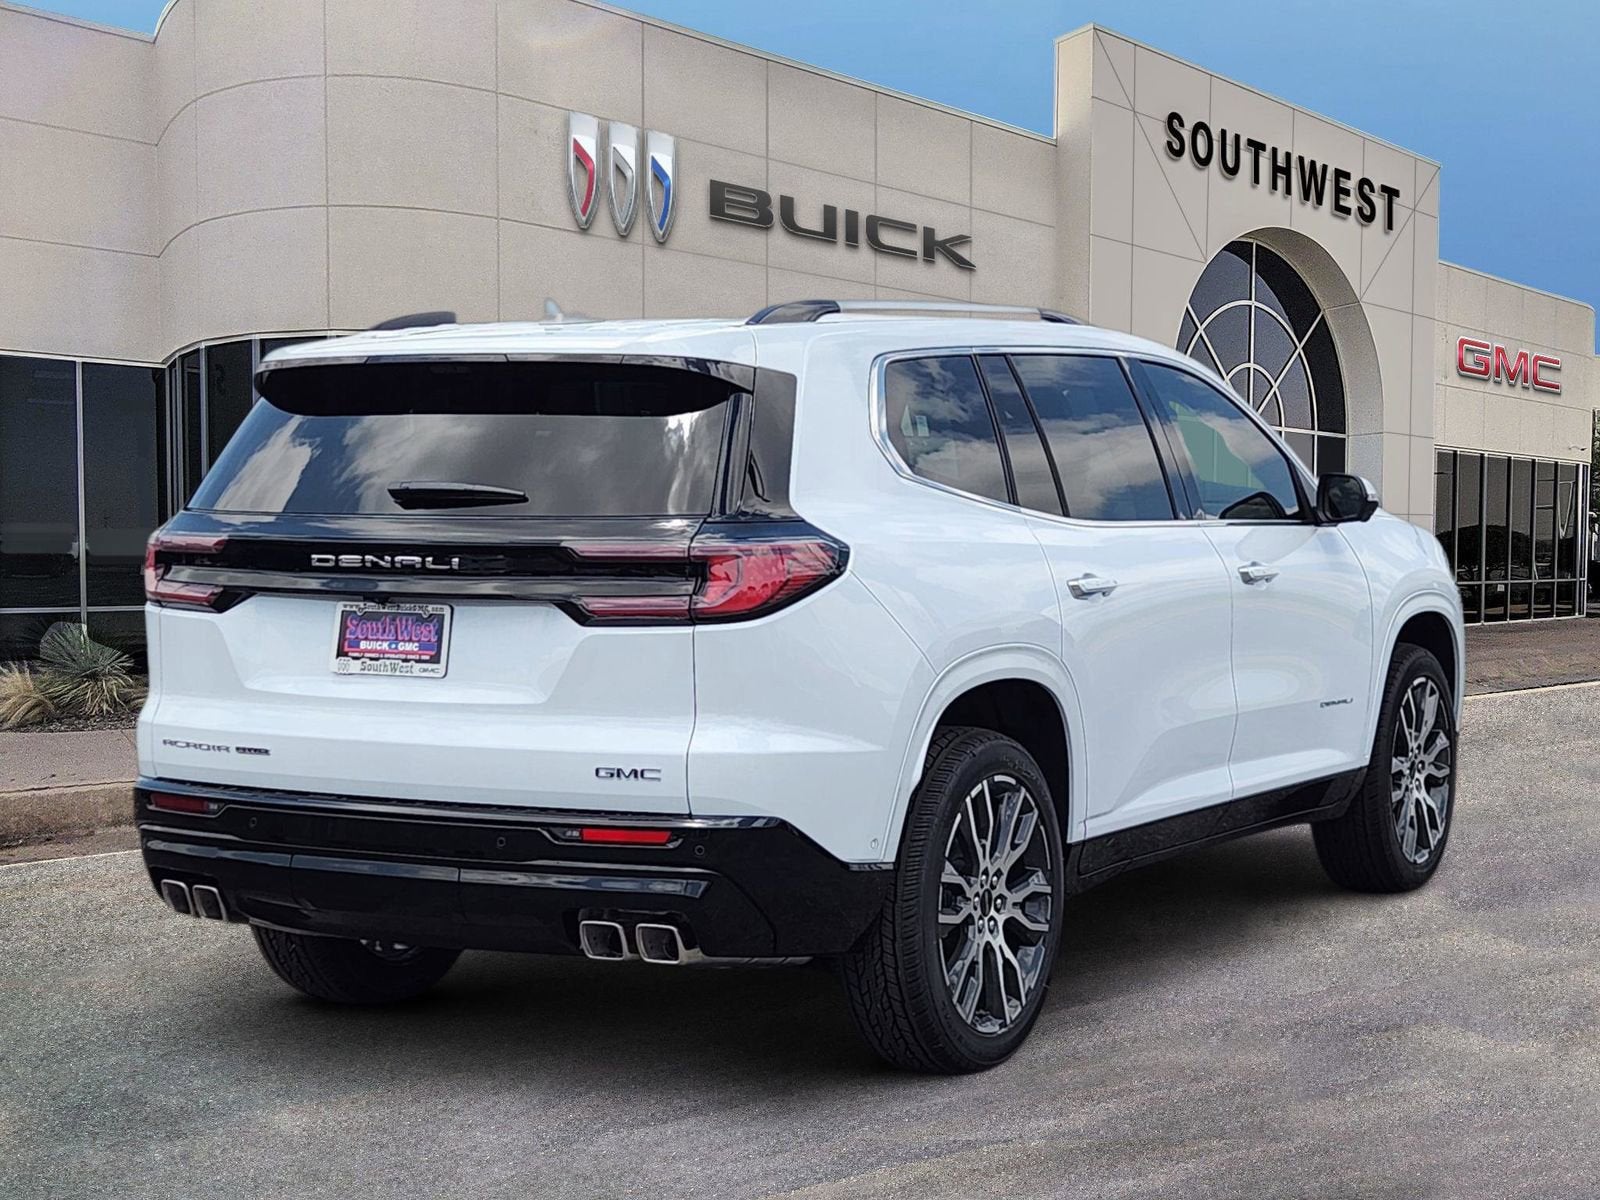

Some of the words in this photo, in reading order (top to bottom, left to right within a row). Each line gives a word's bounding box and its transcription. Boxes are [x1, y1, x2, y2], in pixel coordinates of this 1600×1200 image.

[1166, 111, 1400, 231] SOUTHWEST
[709, 179, 977, 270] BUICK
[1457, 336, 1561, 394] GMC
[310, 554, 460, 570] DENALI
[359, 640, 389, 650] BUICK
[397, 641, 420, 652] GMC
[359, 661, 414, 675] SouthWest
[162, 739, 231, 753] ACADIA
[594, 766, 662, 782] GMC
